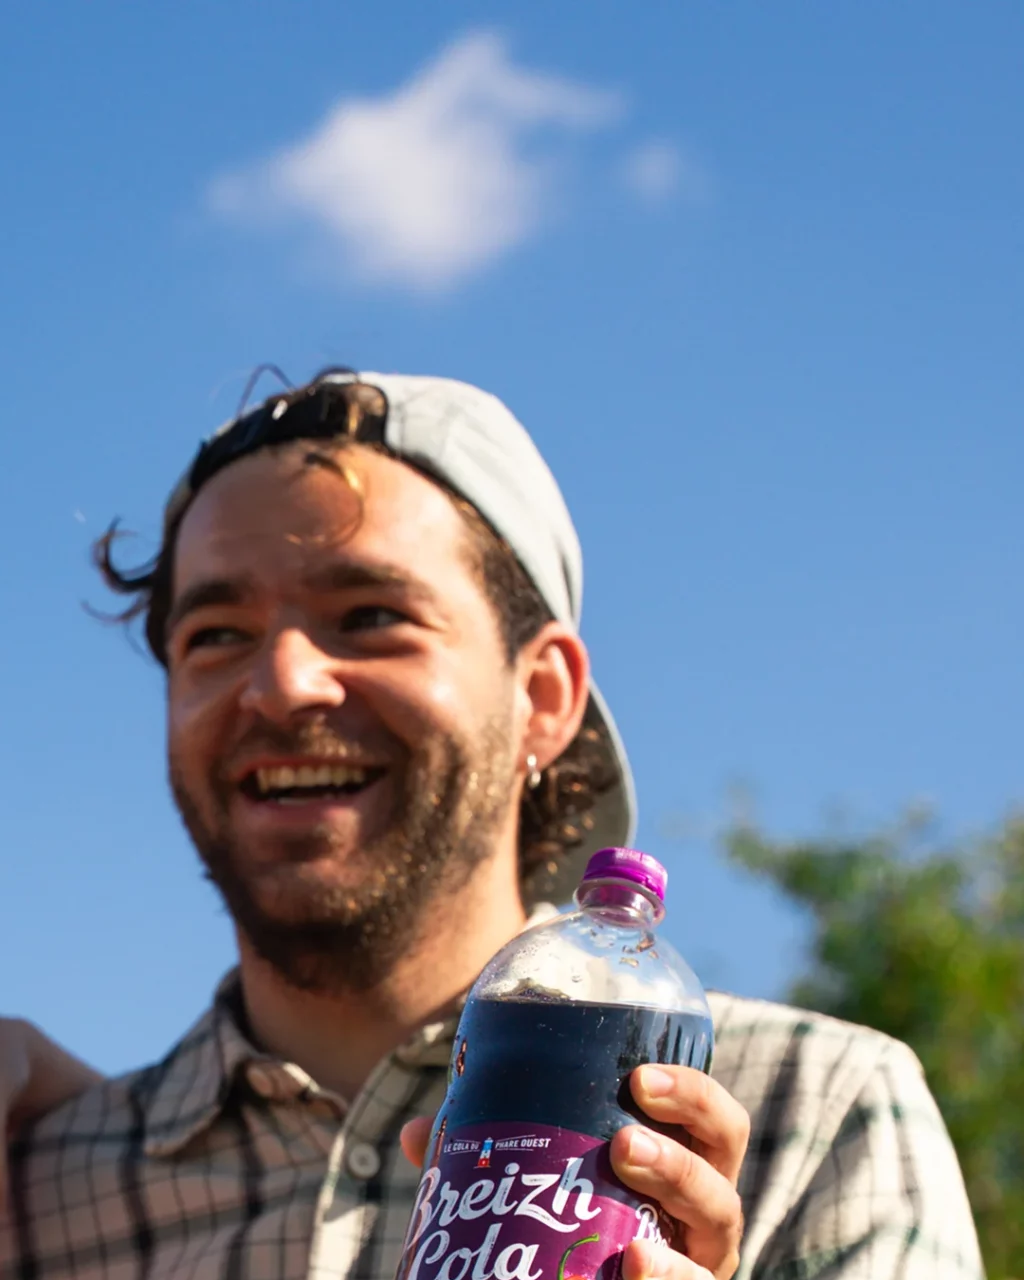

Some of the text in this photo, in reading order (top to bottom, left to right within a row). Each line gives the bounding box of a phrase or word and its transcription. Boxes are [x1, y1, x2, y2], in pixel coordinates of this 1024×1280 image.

[443, 1138, 552, 1154] LE COLA DU PHARE OUEST
[407, 1156, 602, 1249] Breizh
